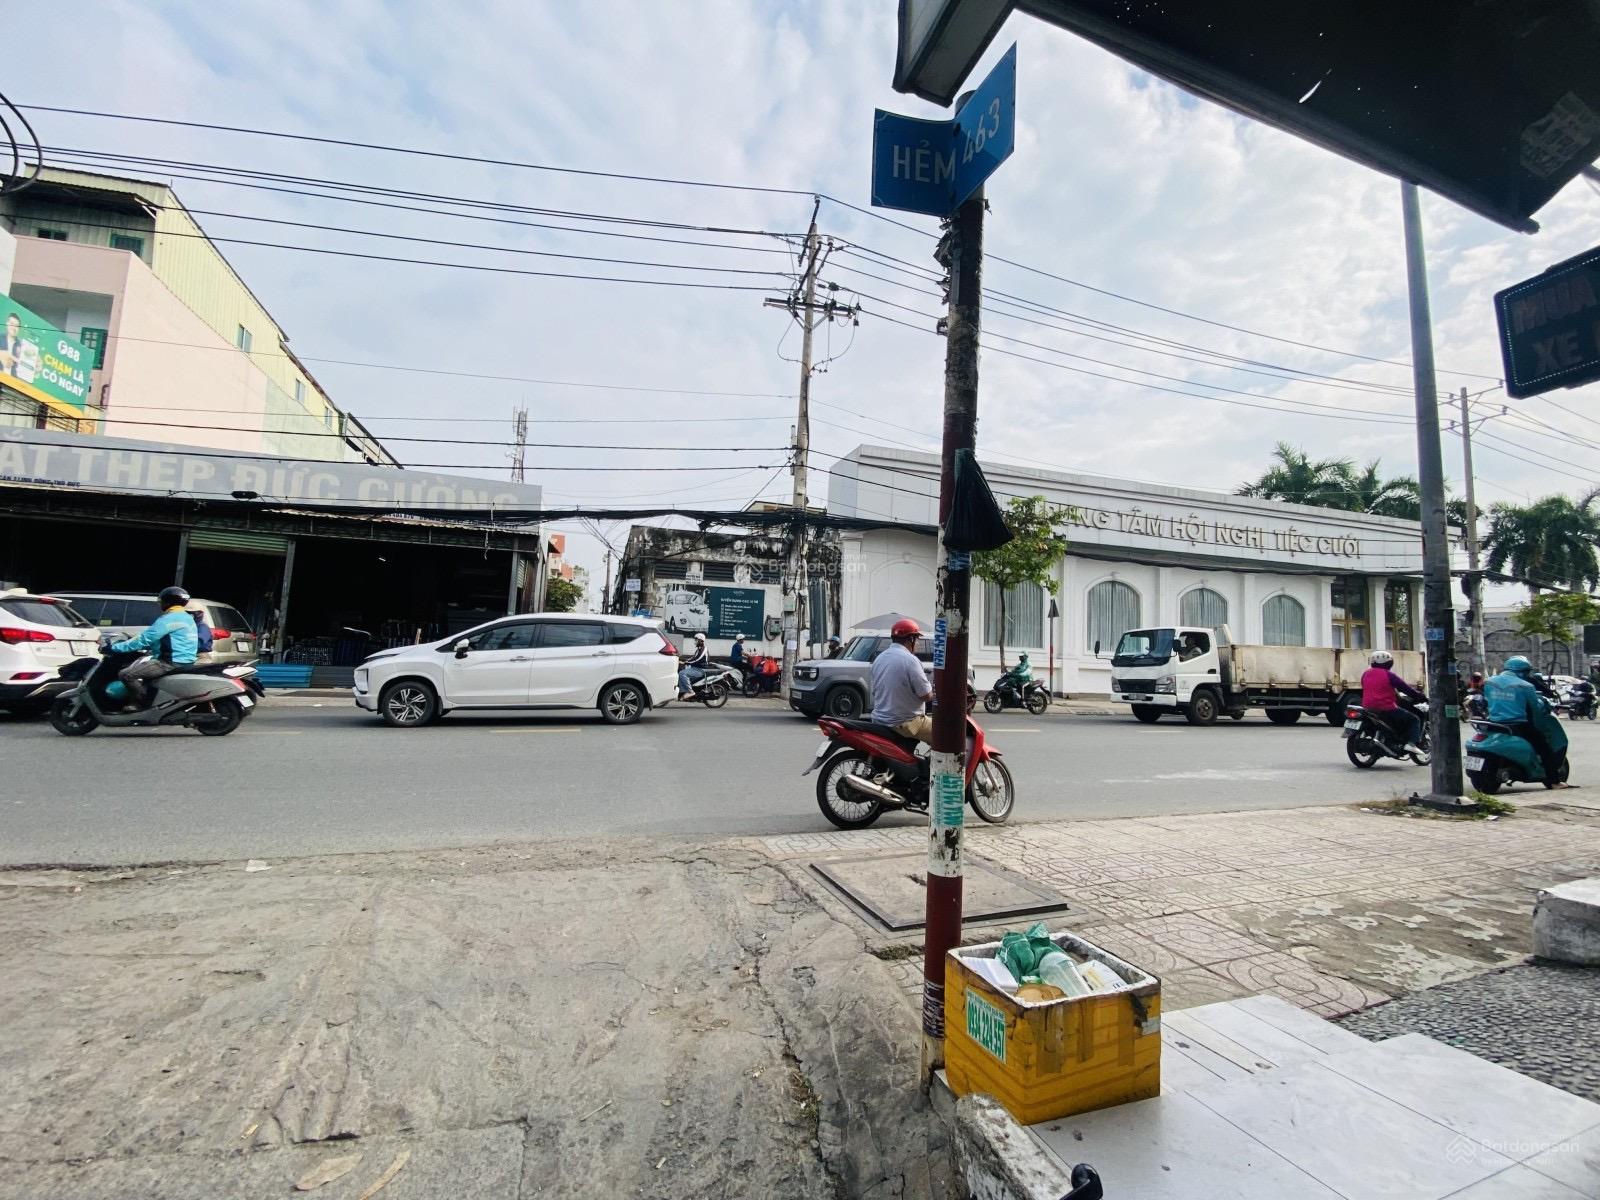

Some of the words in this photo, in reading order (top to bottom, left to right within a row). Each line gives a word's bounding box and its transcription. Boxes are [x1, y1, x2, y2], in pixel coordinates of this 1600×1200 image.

[892, 139, 956, 185] HẺM
[962, 97, 1000, 165] 463
[44, 354, 73, 376] CHẠM
[73, 369, 85, 384] LÀ
[1532, 331, 1583, 377] XE
[42, 369, 58, 383] CÓ
[59, 378, 85, 397] NGAY
[77, 446, 215, 494] THÉP
[229, 461, 340, 503] ĐỨC
[1117, 506, 1162, 537] TÂM
[1170, 512, 1208, 546] HỘI
[1215, 522, 1264, 553] NGHỊ
[1274, 526, 1313, 557] TIỆC
